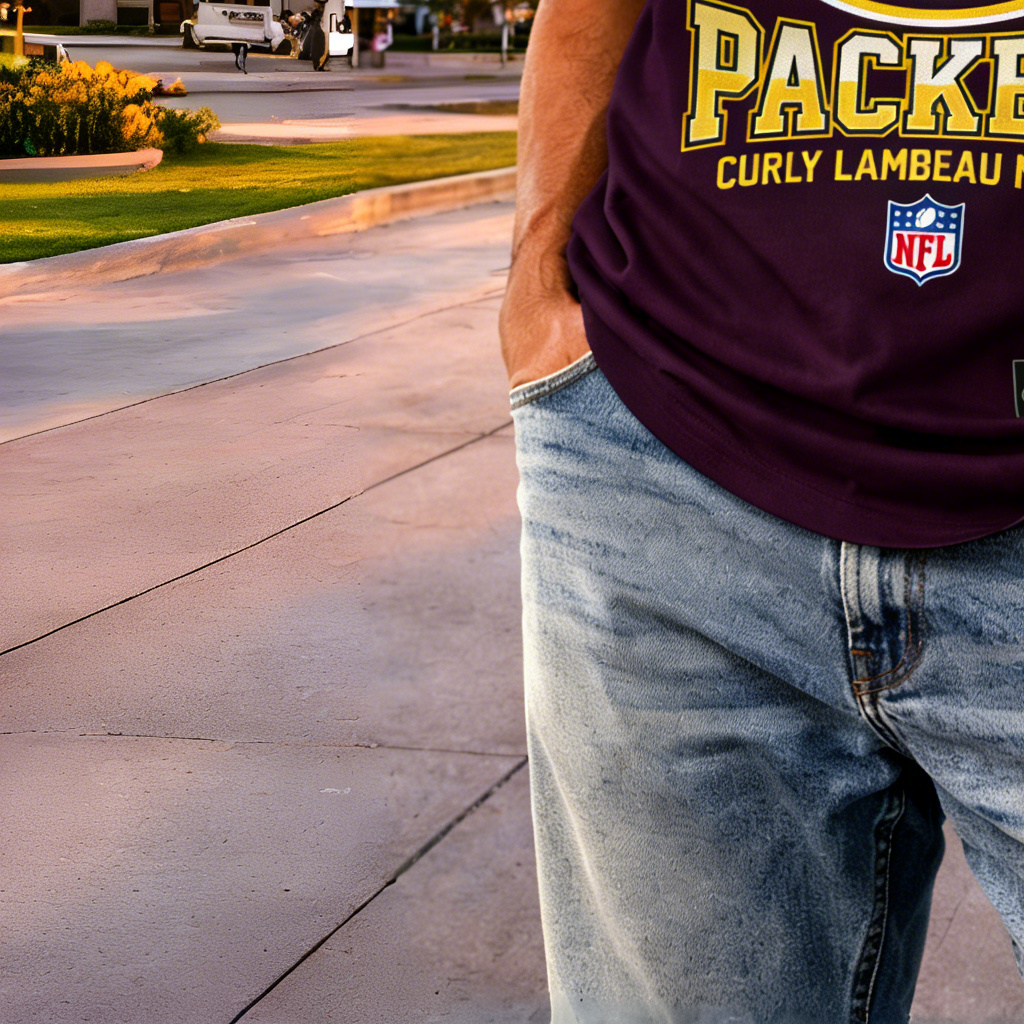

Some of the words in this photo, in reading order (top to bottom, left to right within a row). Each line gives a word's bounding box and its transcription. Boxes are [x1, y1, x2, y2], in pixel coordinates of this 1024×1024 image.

[716, 150, 824, 190] CURLY
[834, 149, 1003, 186] LAMBEAU
[891, 232, 952, 271] NFL
